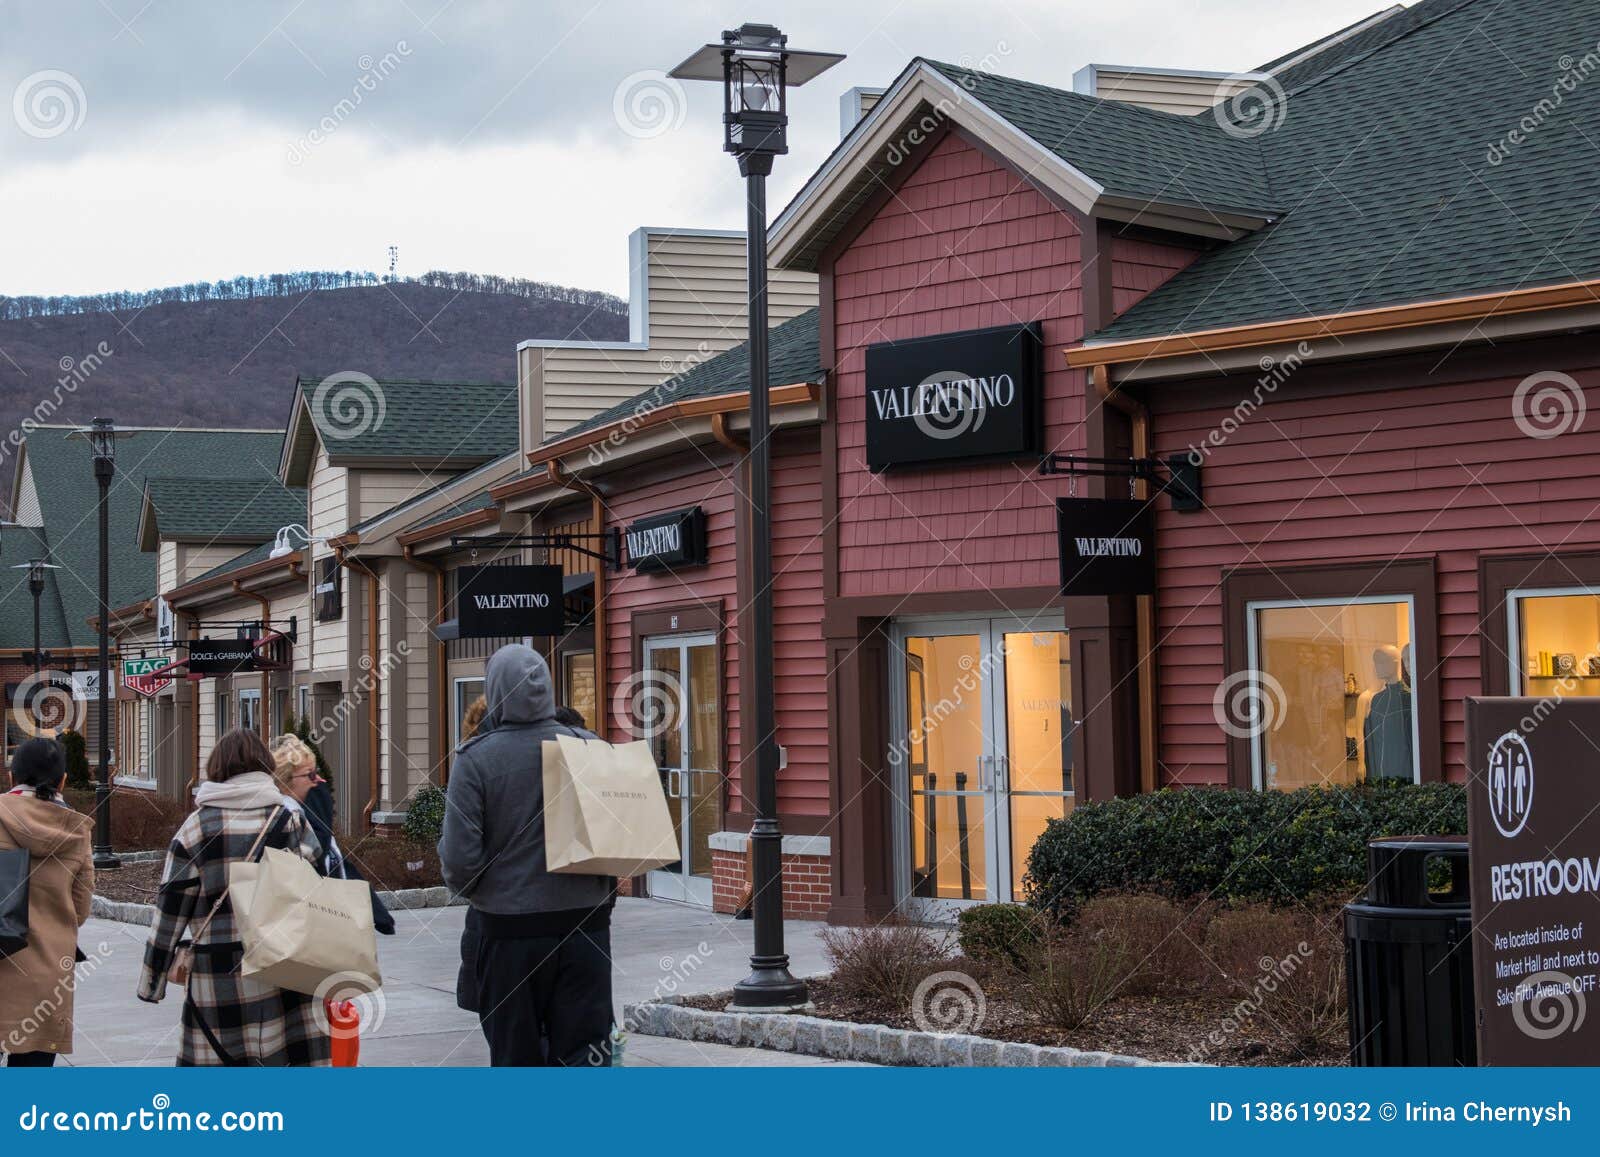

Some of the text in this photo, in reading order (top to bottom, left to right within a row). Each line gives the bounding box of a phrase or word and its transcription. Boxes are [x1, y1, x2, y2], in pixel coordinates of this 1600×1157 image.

[871, 374, 1015, 420] VALENTINO
[626, 523, 679, 560] VALENTINO
[1075, 537, 1142, 556] VALENTINO
[473, 593, 549, 609] VALENTINO
[1494, 922, 1583, 951] Are located inside of
[1496, 950, 1600, 979] Market Hall and next to
[1497, 974, 1596, 1007] Saks Fifth Avenue OFF
